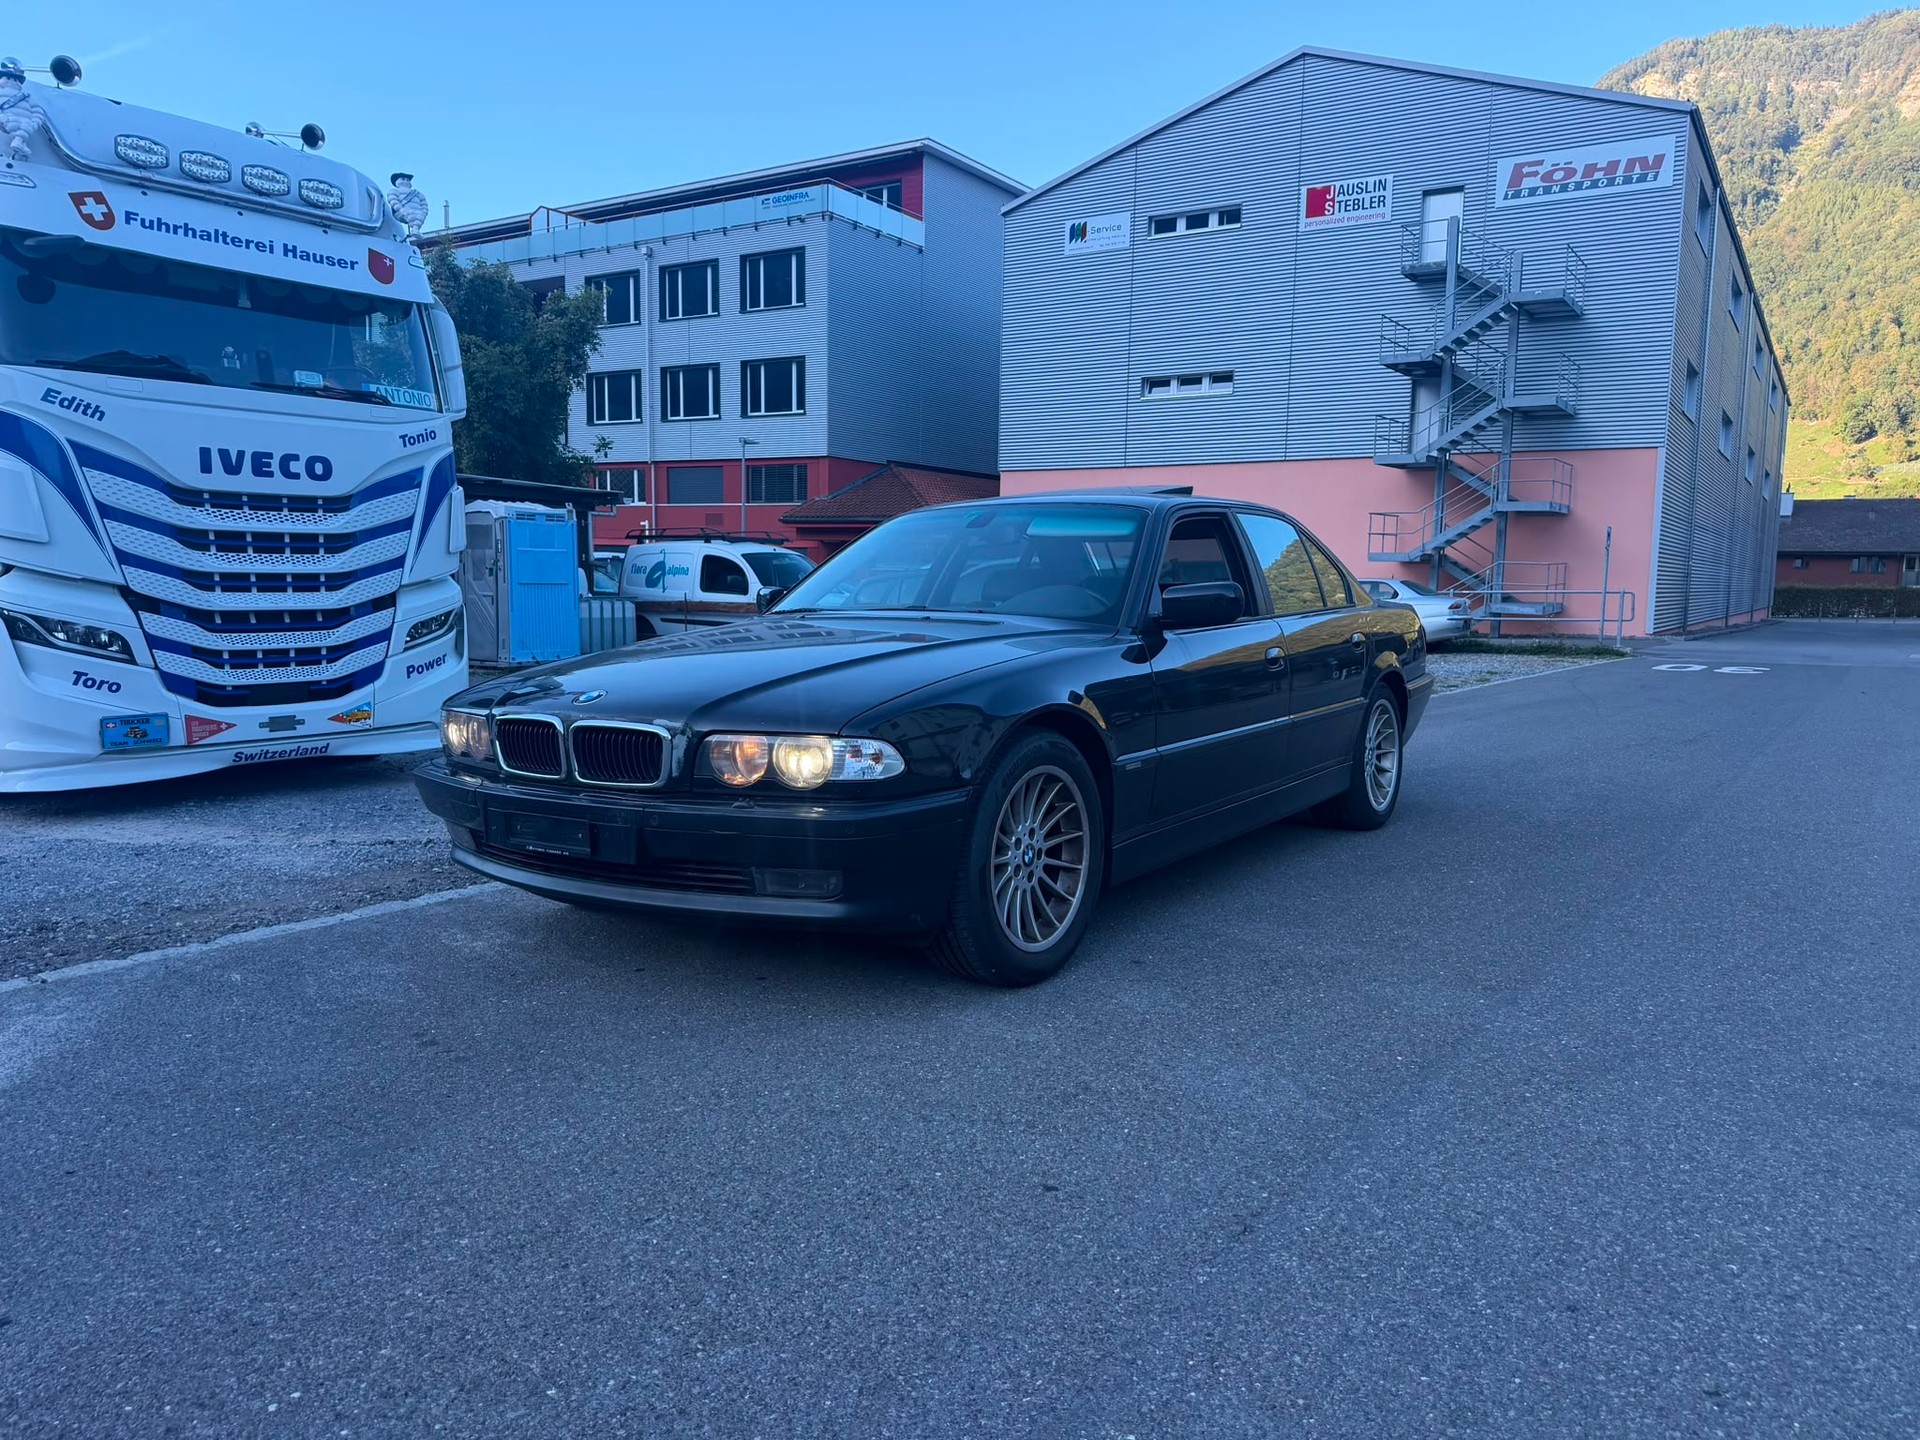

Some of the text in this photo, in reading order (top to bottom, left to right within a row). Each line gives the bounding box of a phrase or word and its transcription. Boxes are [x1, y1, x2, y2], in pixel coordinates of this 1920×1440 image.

[1326, 178, 1388, 200] JAUSLIN
[1506, 173, 1656, 199] TRANSPORTE
[771, 191, 810, 204] GEOINFRA
[1324, 194, 1387, 215] STEBLER
[1304, 212, 1386, 229] personalized engineering
[124, 209, 359, 271] Fuhrhalterei Hauser
[40, 387, 106, 421] Edith
[374, 386, 432, 407] ANTONIO
[399, 428, 437, 448] Tonio
[199, 446, 333, 481] IVECO
[631, 563, 647, 575] flora
[666, 564, 689, 577] alpina
[406, 653, 447, 679] Power
[72, 670, 122, 693] Toro
[232, 742, 330, 763] Switzerland
